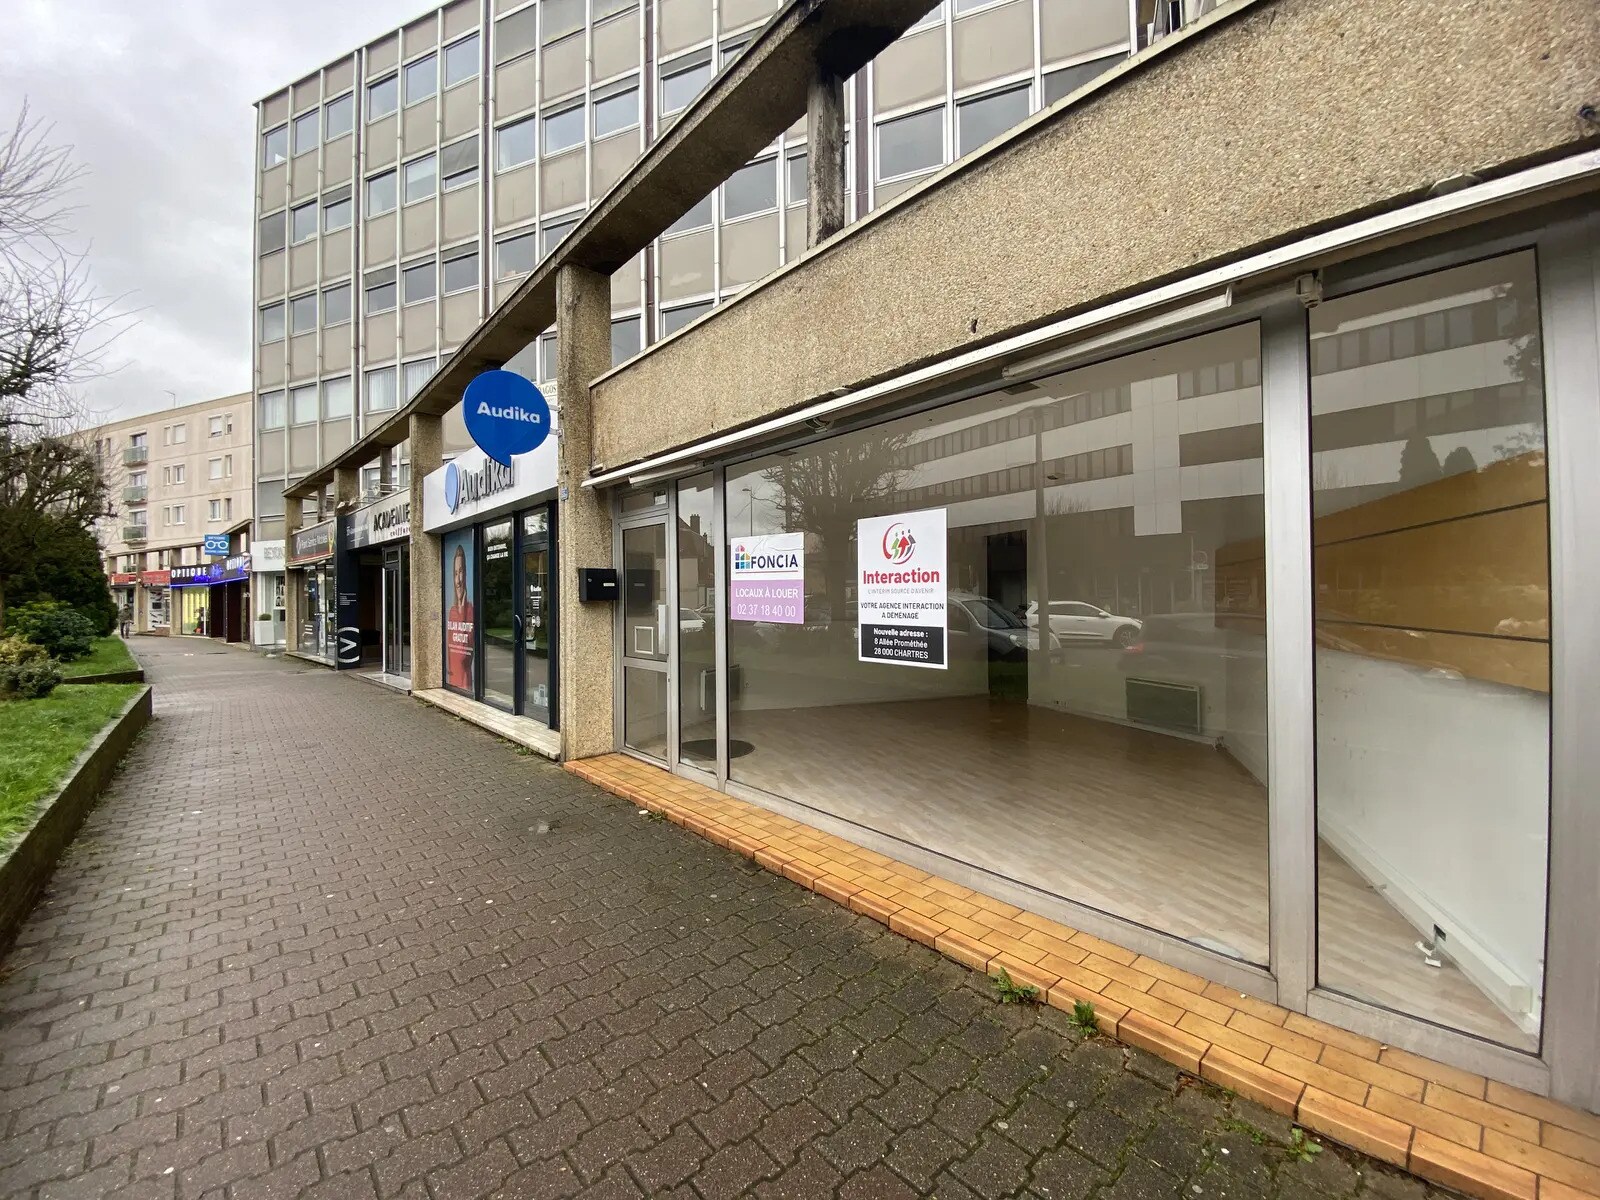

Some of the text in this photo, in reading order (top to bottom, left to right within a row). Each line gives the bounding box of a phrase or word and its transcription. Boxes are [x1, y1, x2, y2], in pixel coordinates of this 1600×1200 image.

[477, 401, 541, 424] Audika
[751, 554, 798, 569] FONCIA
[171, 566, 207, 579] OPTIQUE
[863, 567, 940, 585] Interaction
[735, 586, 799, 599] LOCAUX À LOUER
[737, 603, 796, 617] 02 37 18 40 00
[878, 602, 902, 610] AGENCE
[902, 602, 944, 610] INTERACTION
[873, 627, 899, 636] Nouvelle
[899, 629, 925, 638] adresse
[874, 637, 928, 649] 8 Allée Prométhée
[894, 648, 929, 659] CHARTRES
